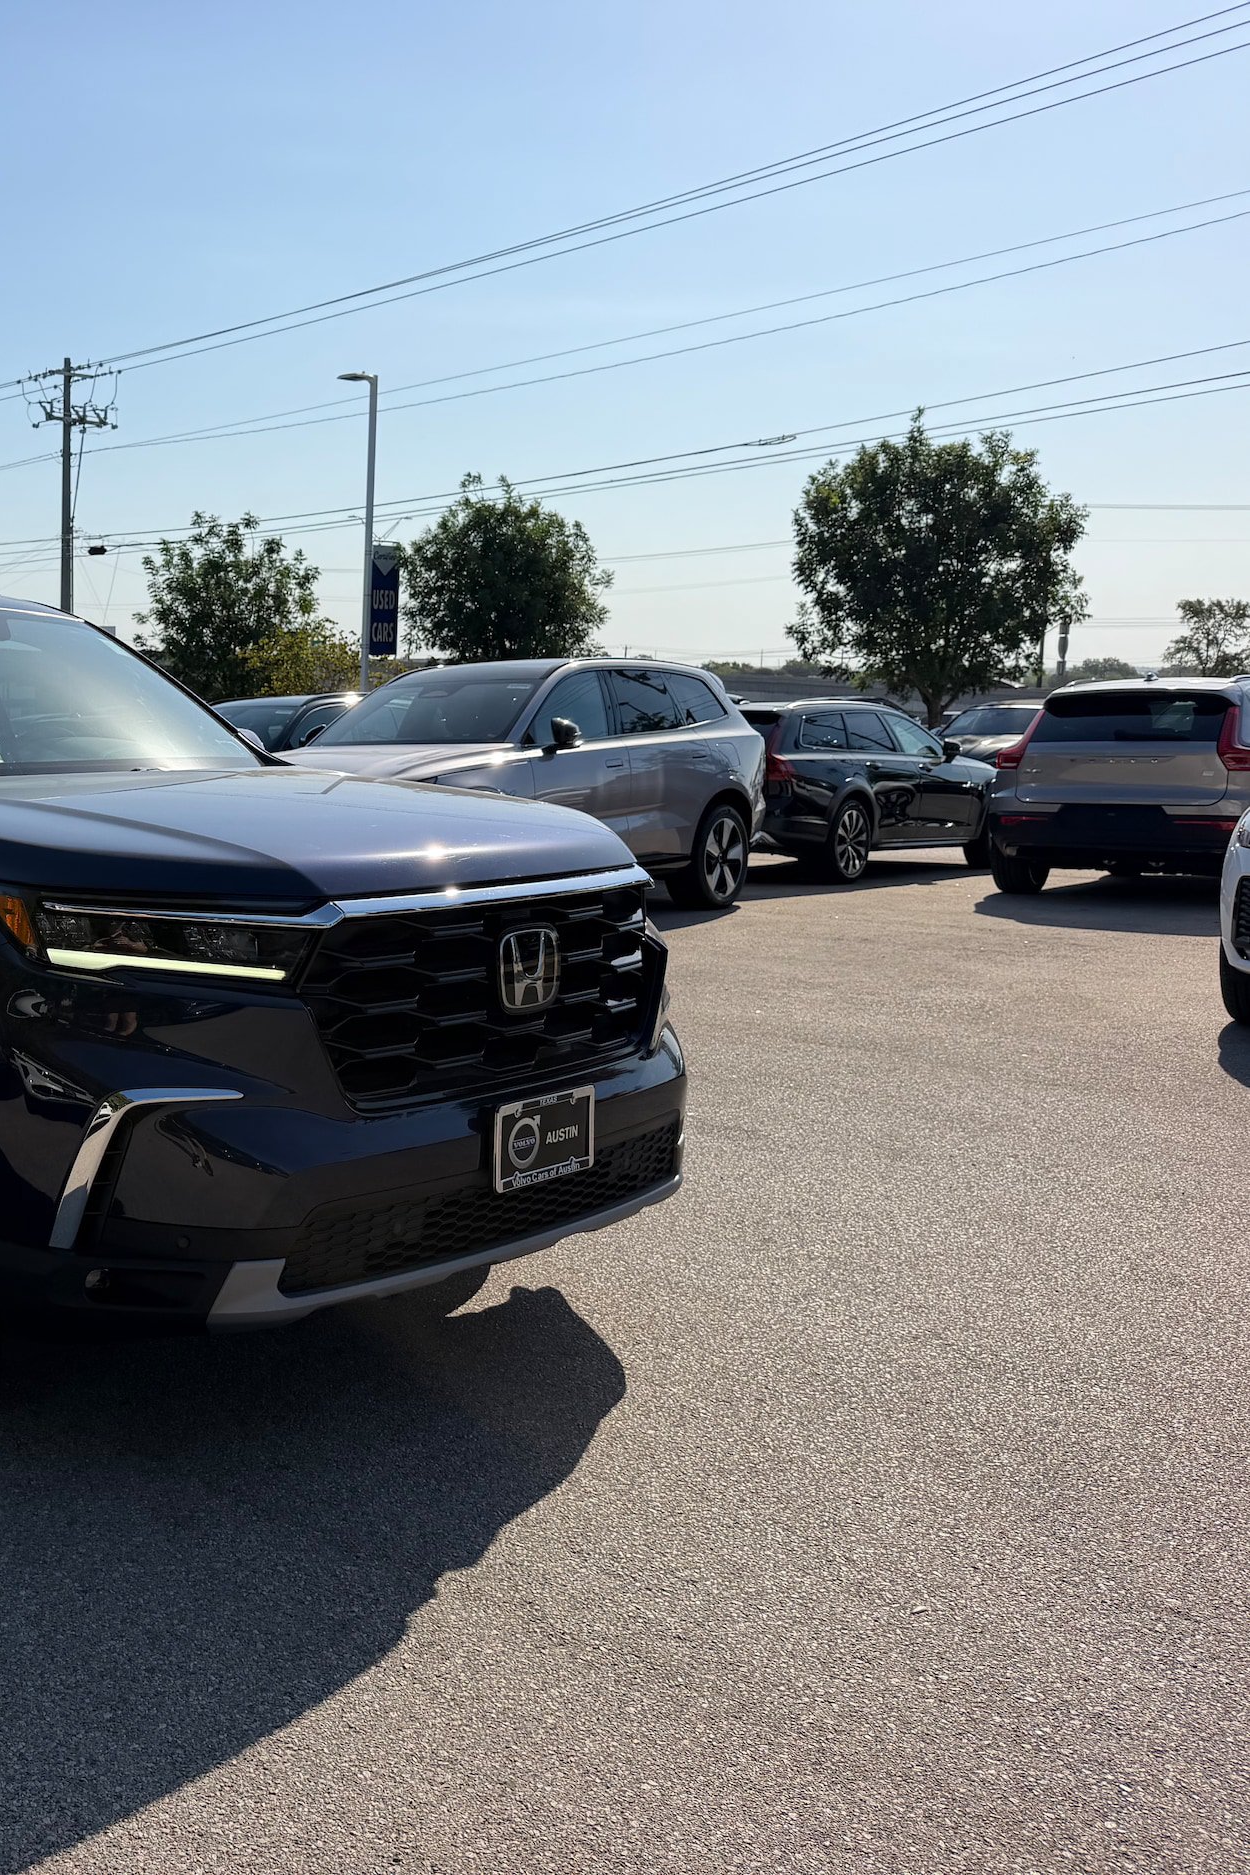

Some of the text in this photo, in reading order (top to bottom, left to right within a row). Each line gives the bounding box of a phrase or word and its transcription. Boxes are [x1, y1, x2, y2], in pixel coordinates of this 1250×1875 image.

[372, 589, 395, 610] USED
[371, 622, 394, 642] CARS
[540, 1096, 558, 1106] TEXAS
[513, 1138, 536, 1149] VOLVO
[546, 1124, 578, 1145] AUSTIN
[512, 1162, 580, 1187] Volvo Cars of Austin
